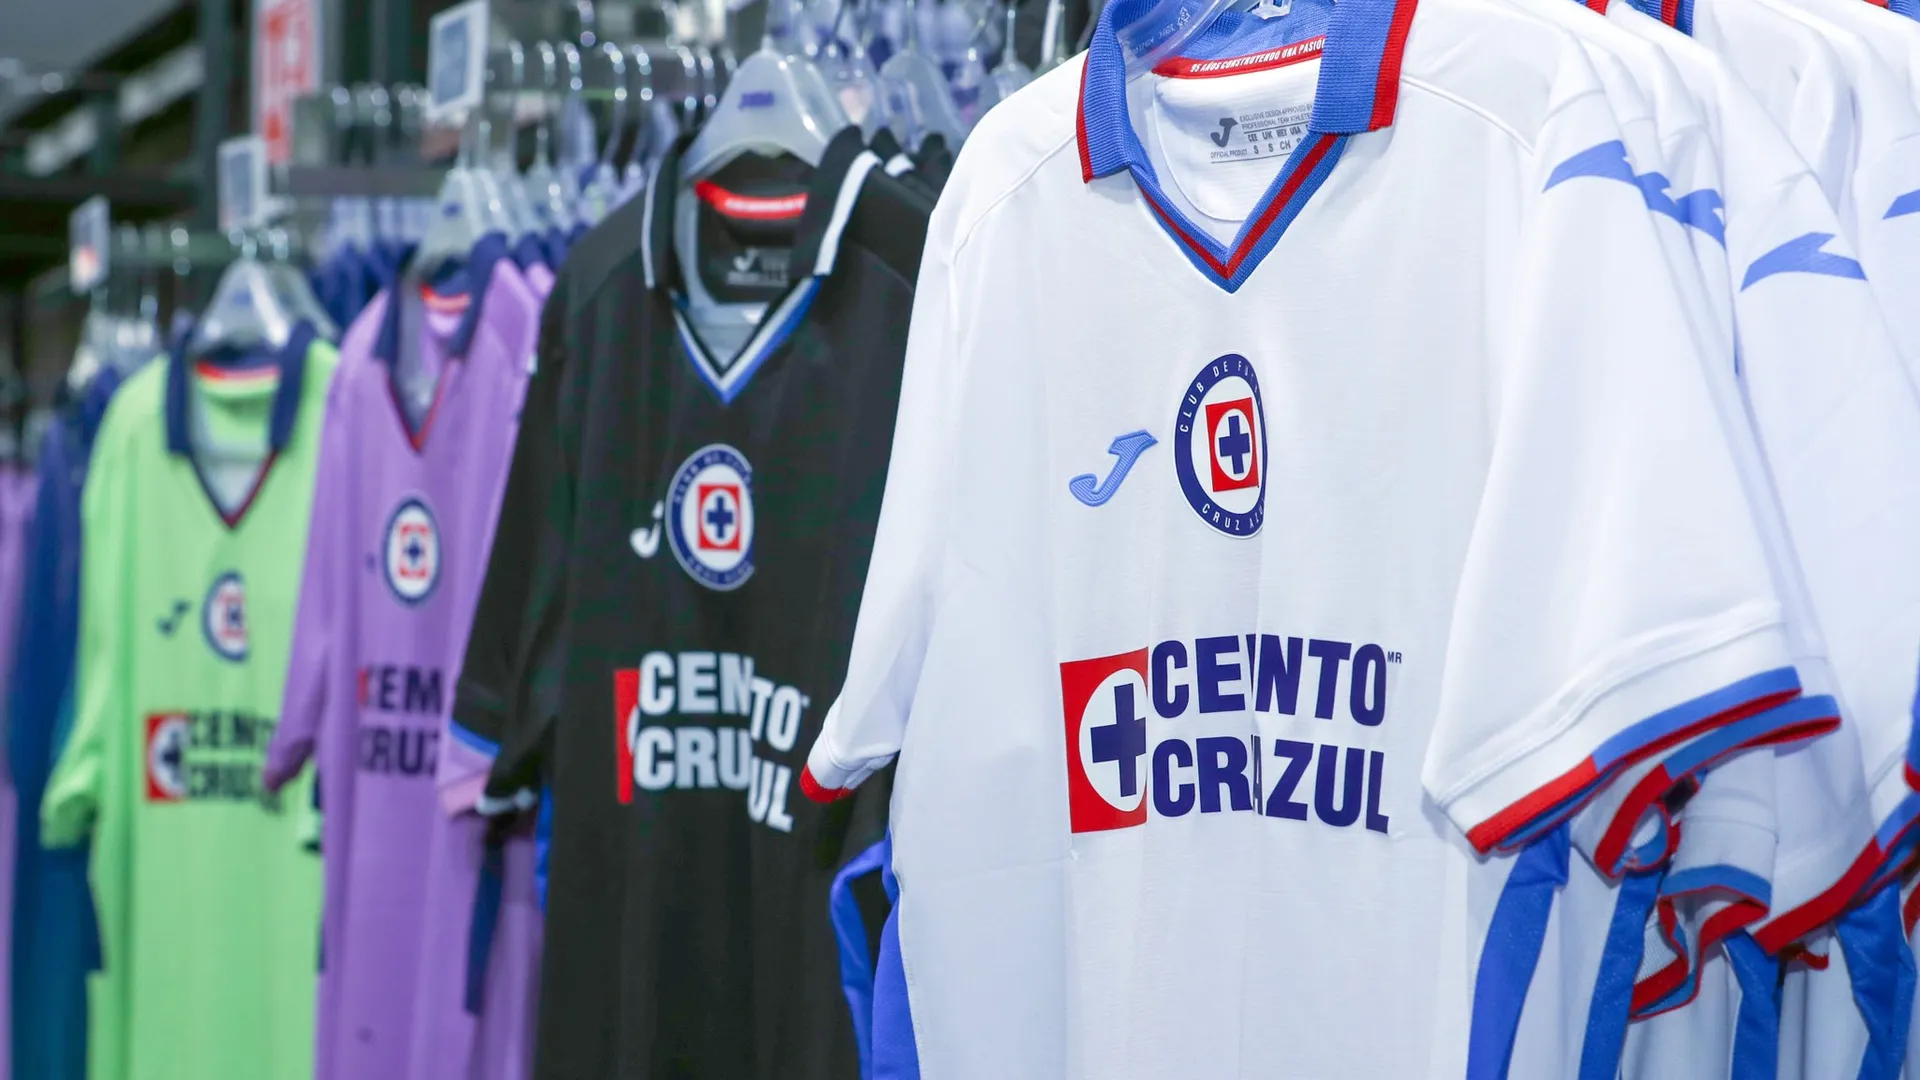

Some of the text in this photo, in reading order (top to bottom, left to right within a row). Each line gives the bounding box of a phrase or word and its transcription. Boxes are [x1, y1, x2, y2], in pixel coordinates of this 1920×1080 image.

[1190, 63, 1201, 72] 95
[1281, 46, 1298, 58] UNA
[1239, 112, 1265, 122] EXCLUSIVE
[1265, 109, 1281, 118] DESIGN
[1241, 118, 1278, 129] PROFESSIONAL
[1262, 130, 1273, 140] UK
[1276, 128, 1287, 138] MEX
[1289, 126, 1302, 135] USA
[1280, 140, 1291, 150] CH
[1210, 148, 1247, 159] OFFICIAL PRODUCT
[1180, 361, 1228, 433] CLUB DE
[1202, 503, 1240, 531] CRUZ
